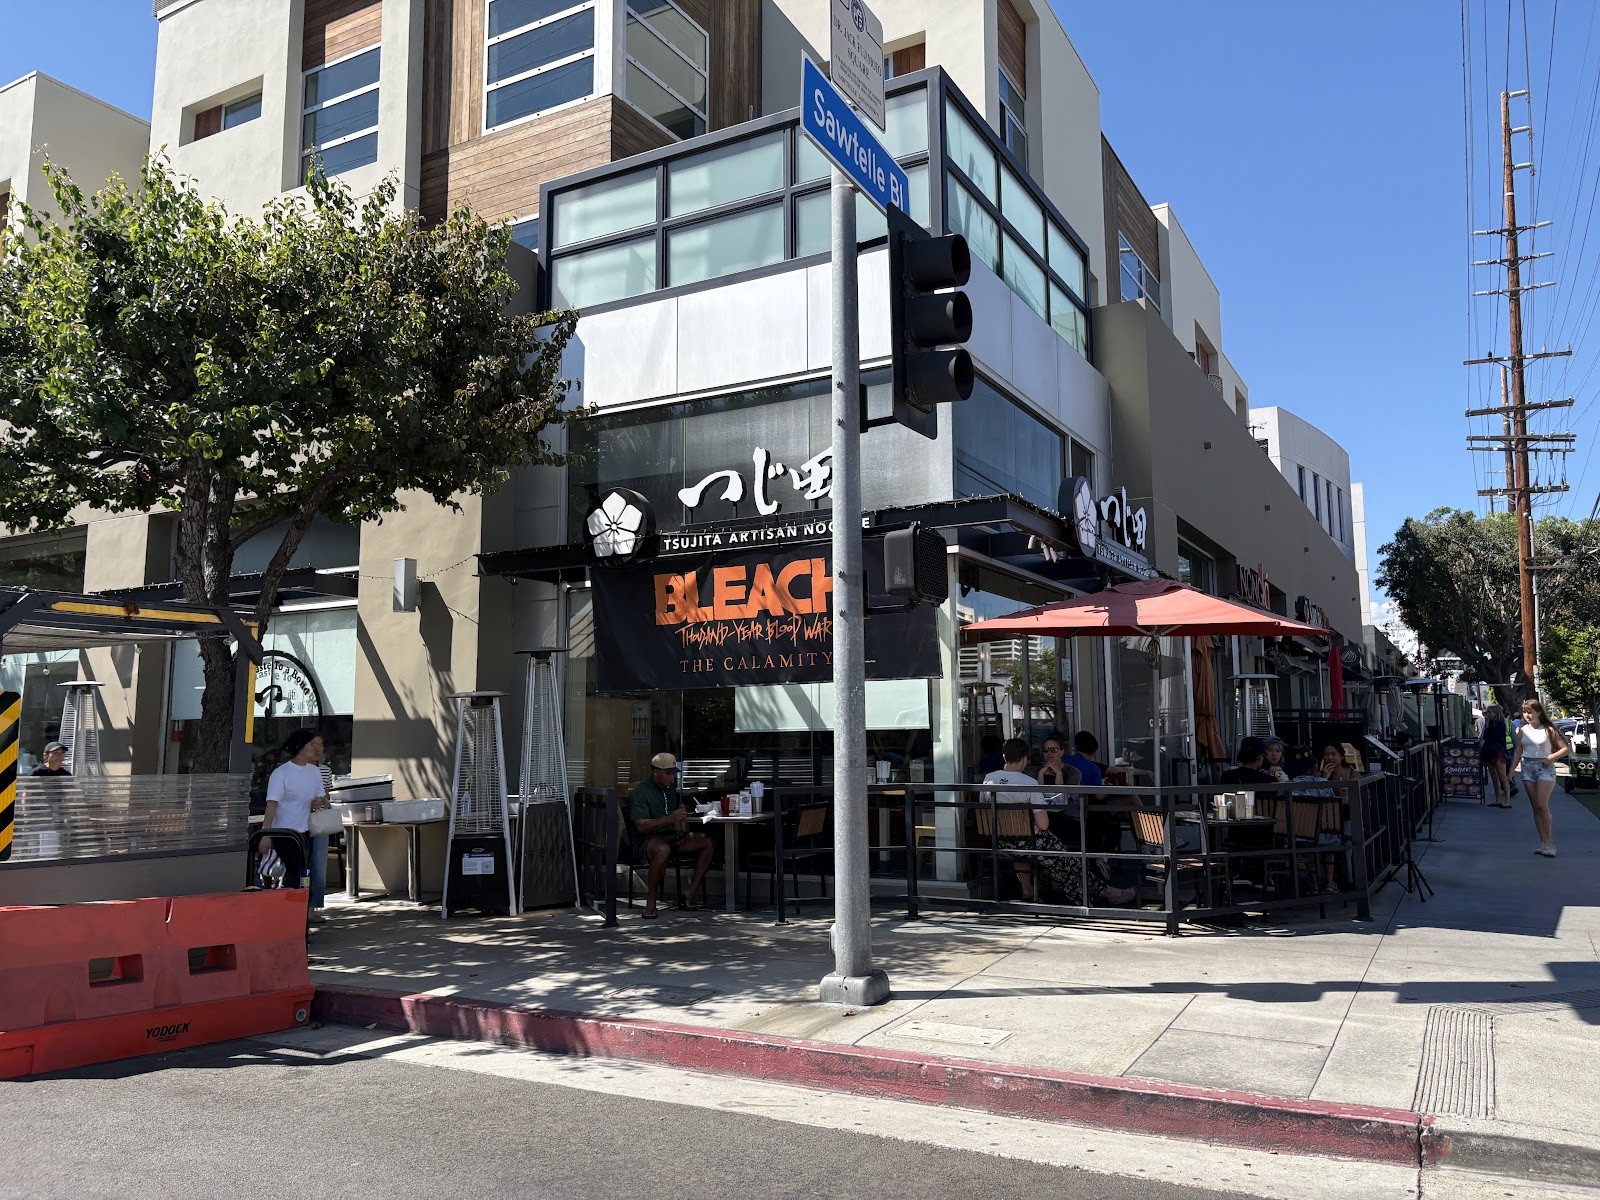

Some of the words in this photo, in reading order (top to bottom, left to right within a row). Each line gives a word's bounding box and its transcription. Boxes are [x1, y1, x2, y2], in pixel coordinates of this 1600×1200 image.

[813, 88, 886, 193] Sawtelle
[889, 172, 904, 212] Bl
[664, 534, 722, 550] TSUJITA
[729, 525, 797, 543] ARTISAN
[804, 518, 870, 535] NOE
[654, 557, 833, 626] BLEACH
[804, 612, 833, 642] WAR
[255, 661, 272, 673] aste
[680, 658, 714, 673] THE
[723, 651, 833, 671] CALAMITY
[146, 1021, 190, 1039] YODOCK
